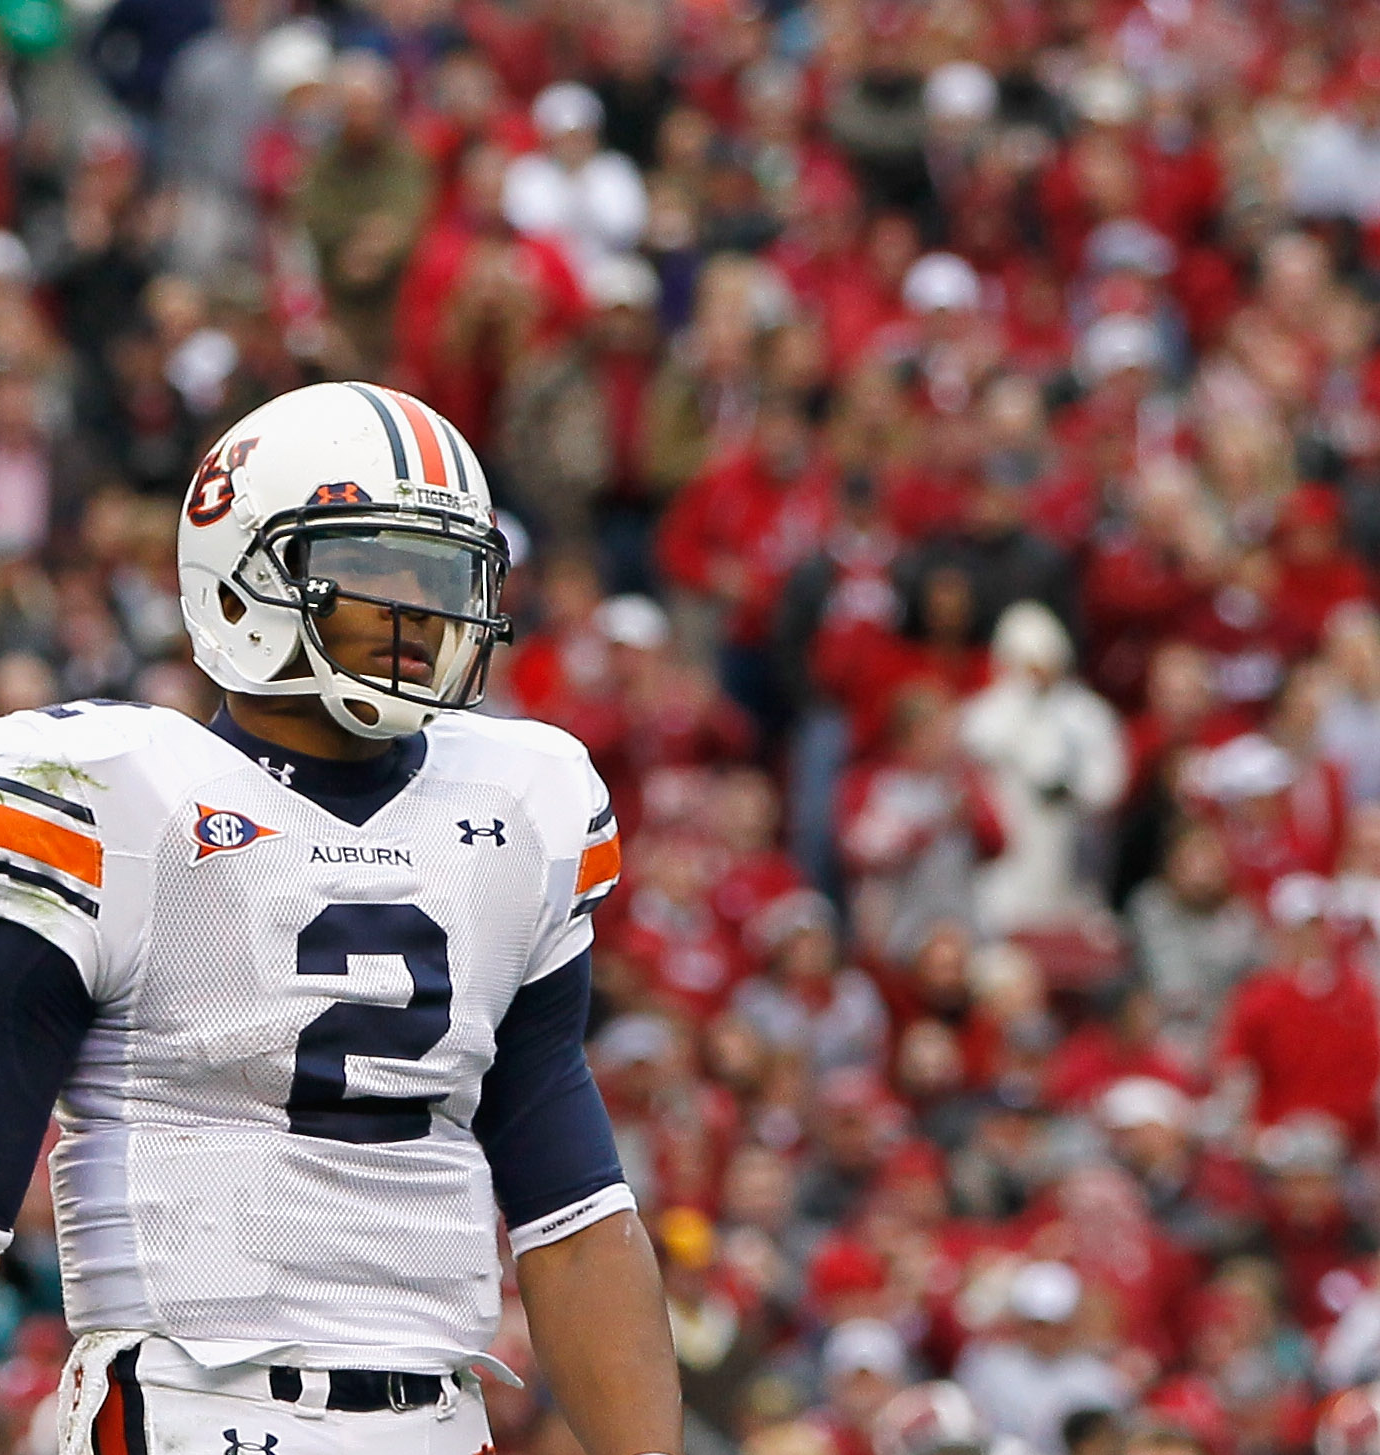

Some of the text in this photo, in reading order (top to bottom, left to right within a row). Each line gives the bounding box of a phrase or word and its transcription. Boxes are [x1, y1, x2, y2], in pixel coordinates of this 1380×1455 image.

[417, 488, 461, 511] TIGERS
[206, 812, 244, 847] SEC
[310, 846, 414, 867] AUBURN
[285, 902, 453, 1145] 2
